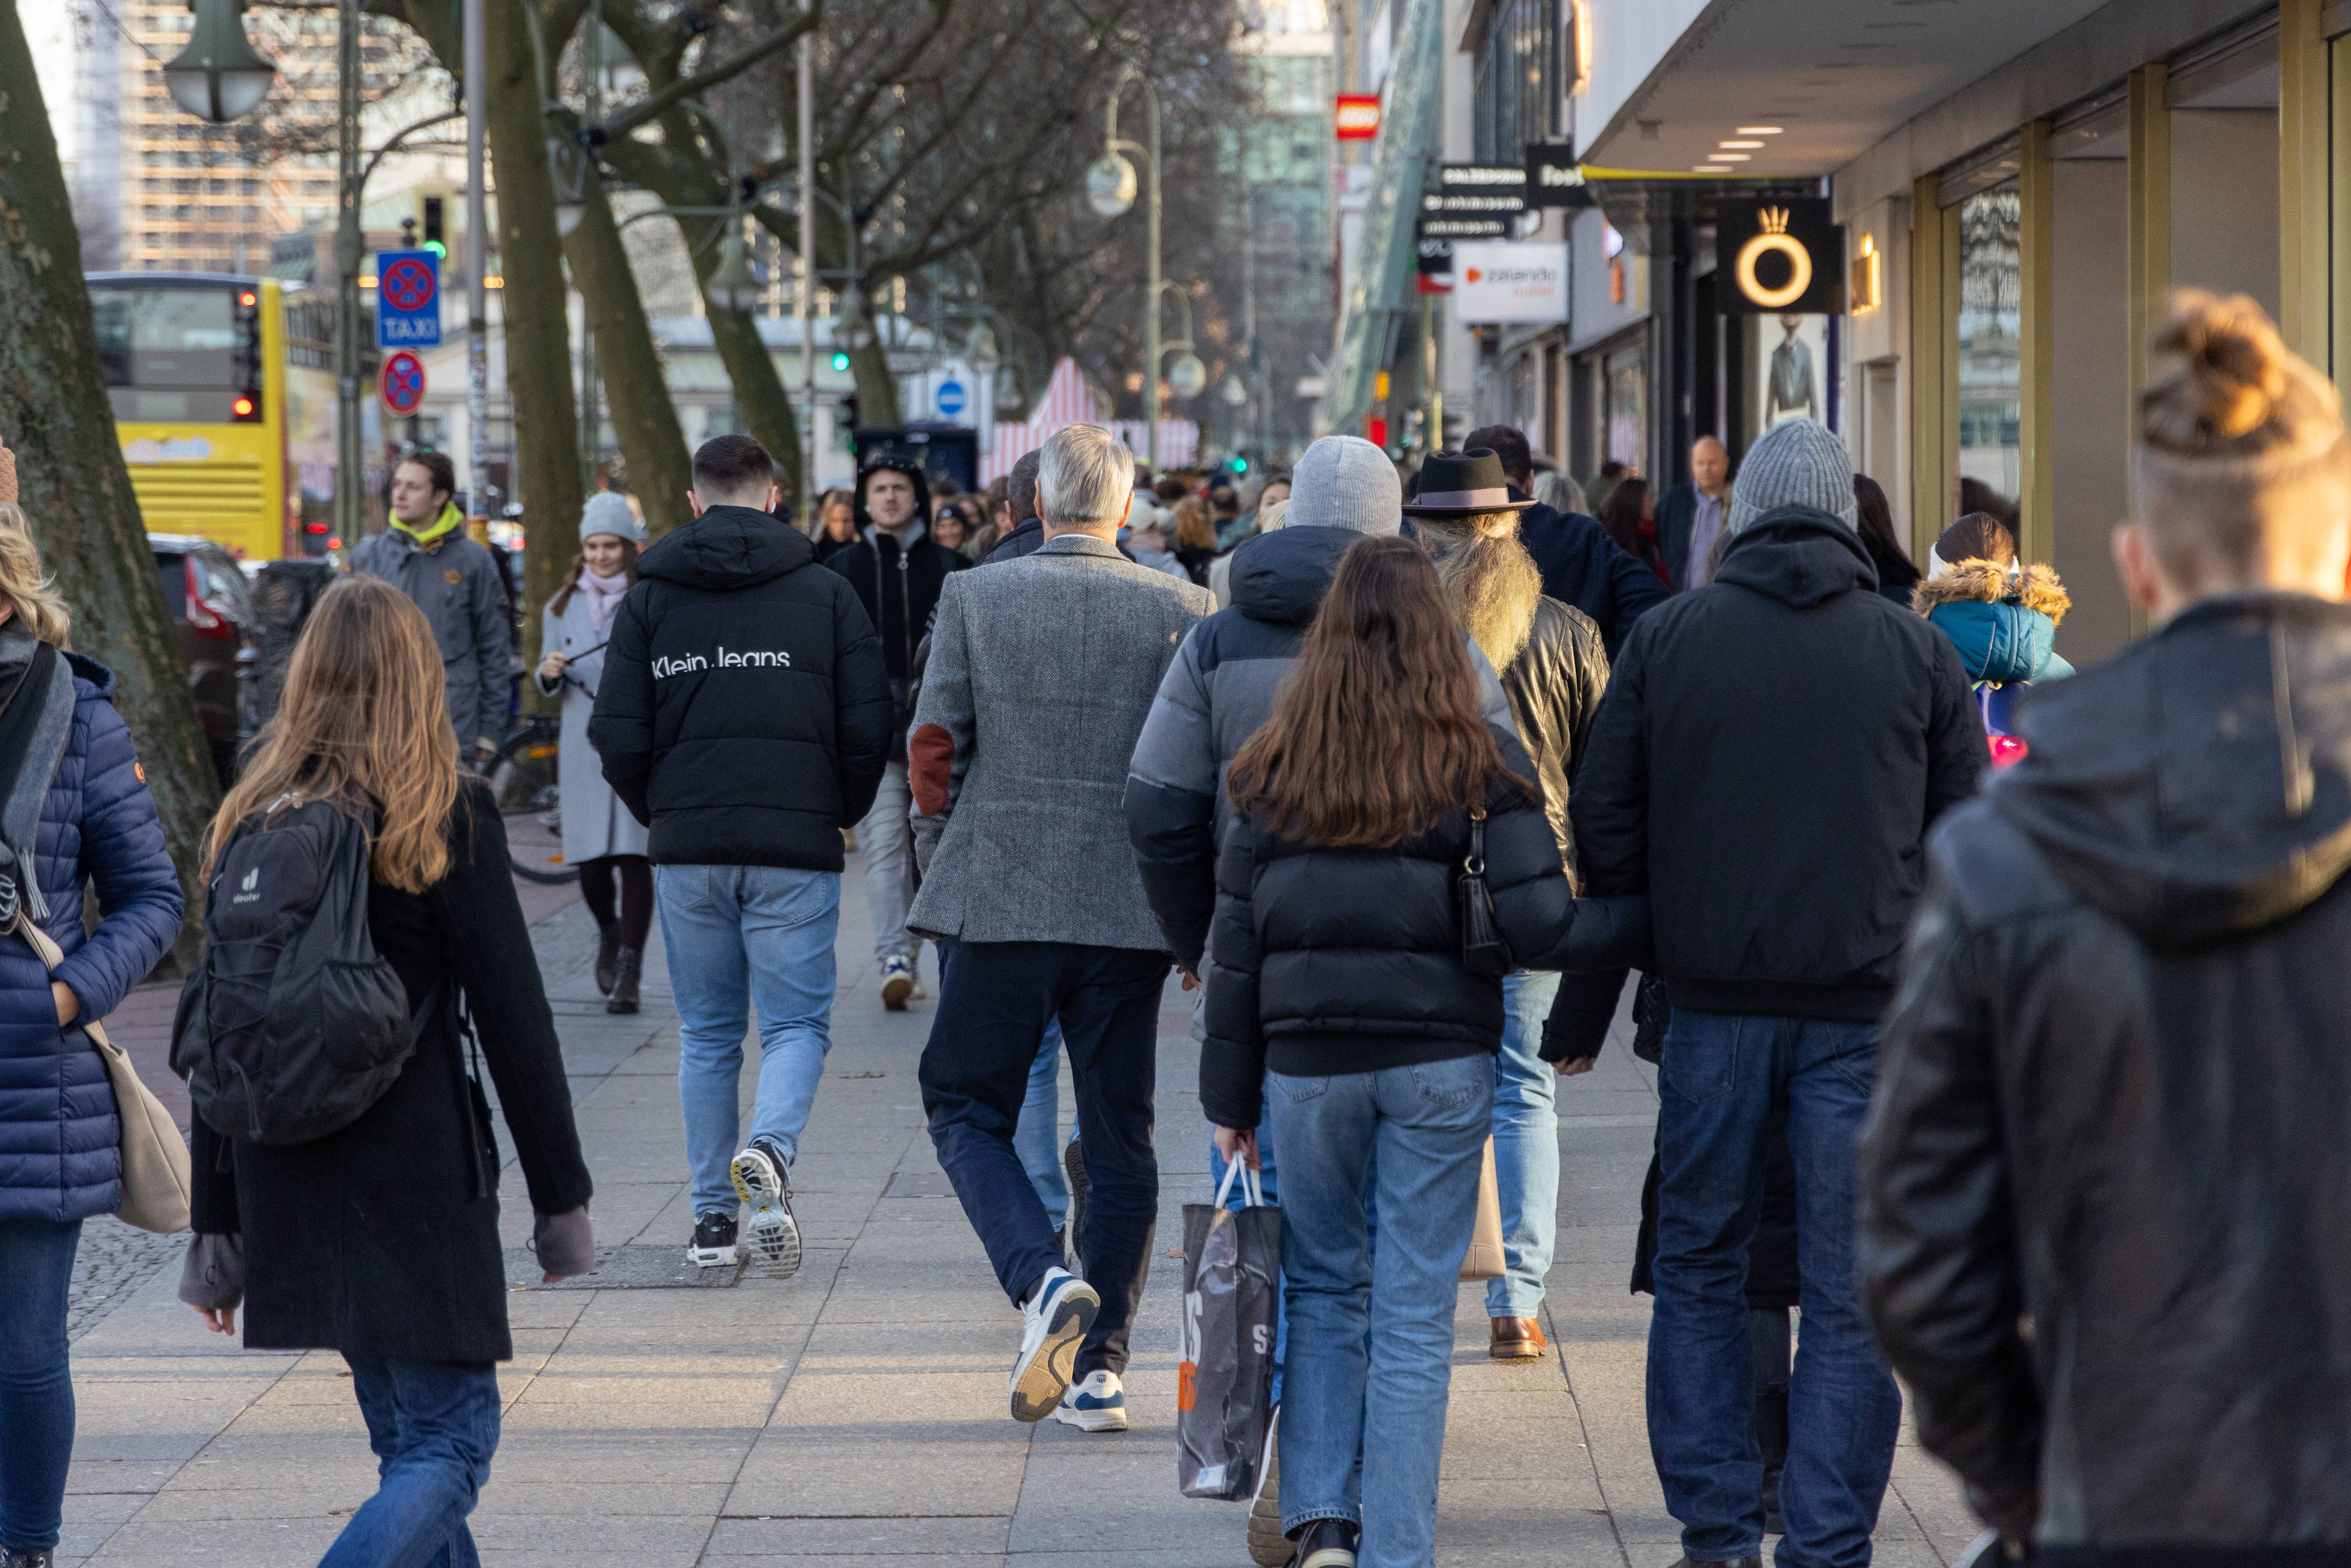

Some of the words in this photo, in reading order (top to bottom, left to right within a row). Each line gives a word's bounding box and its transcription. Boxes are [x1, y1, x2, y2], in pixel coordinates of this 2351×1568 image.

[1488, 267, 1558, 284] zalando
[383, 317, 438, 340] TAXI
[652, 653, 708, 680] Klein
